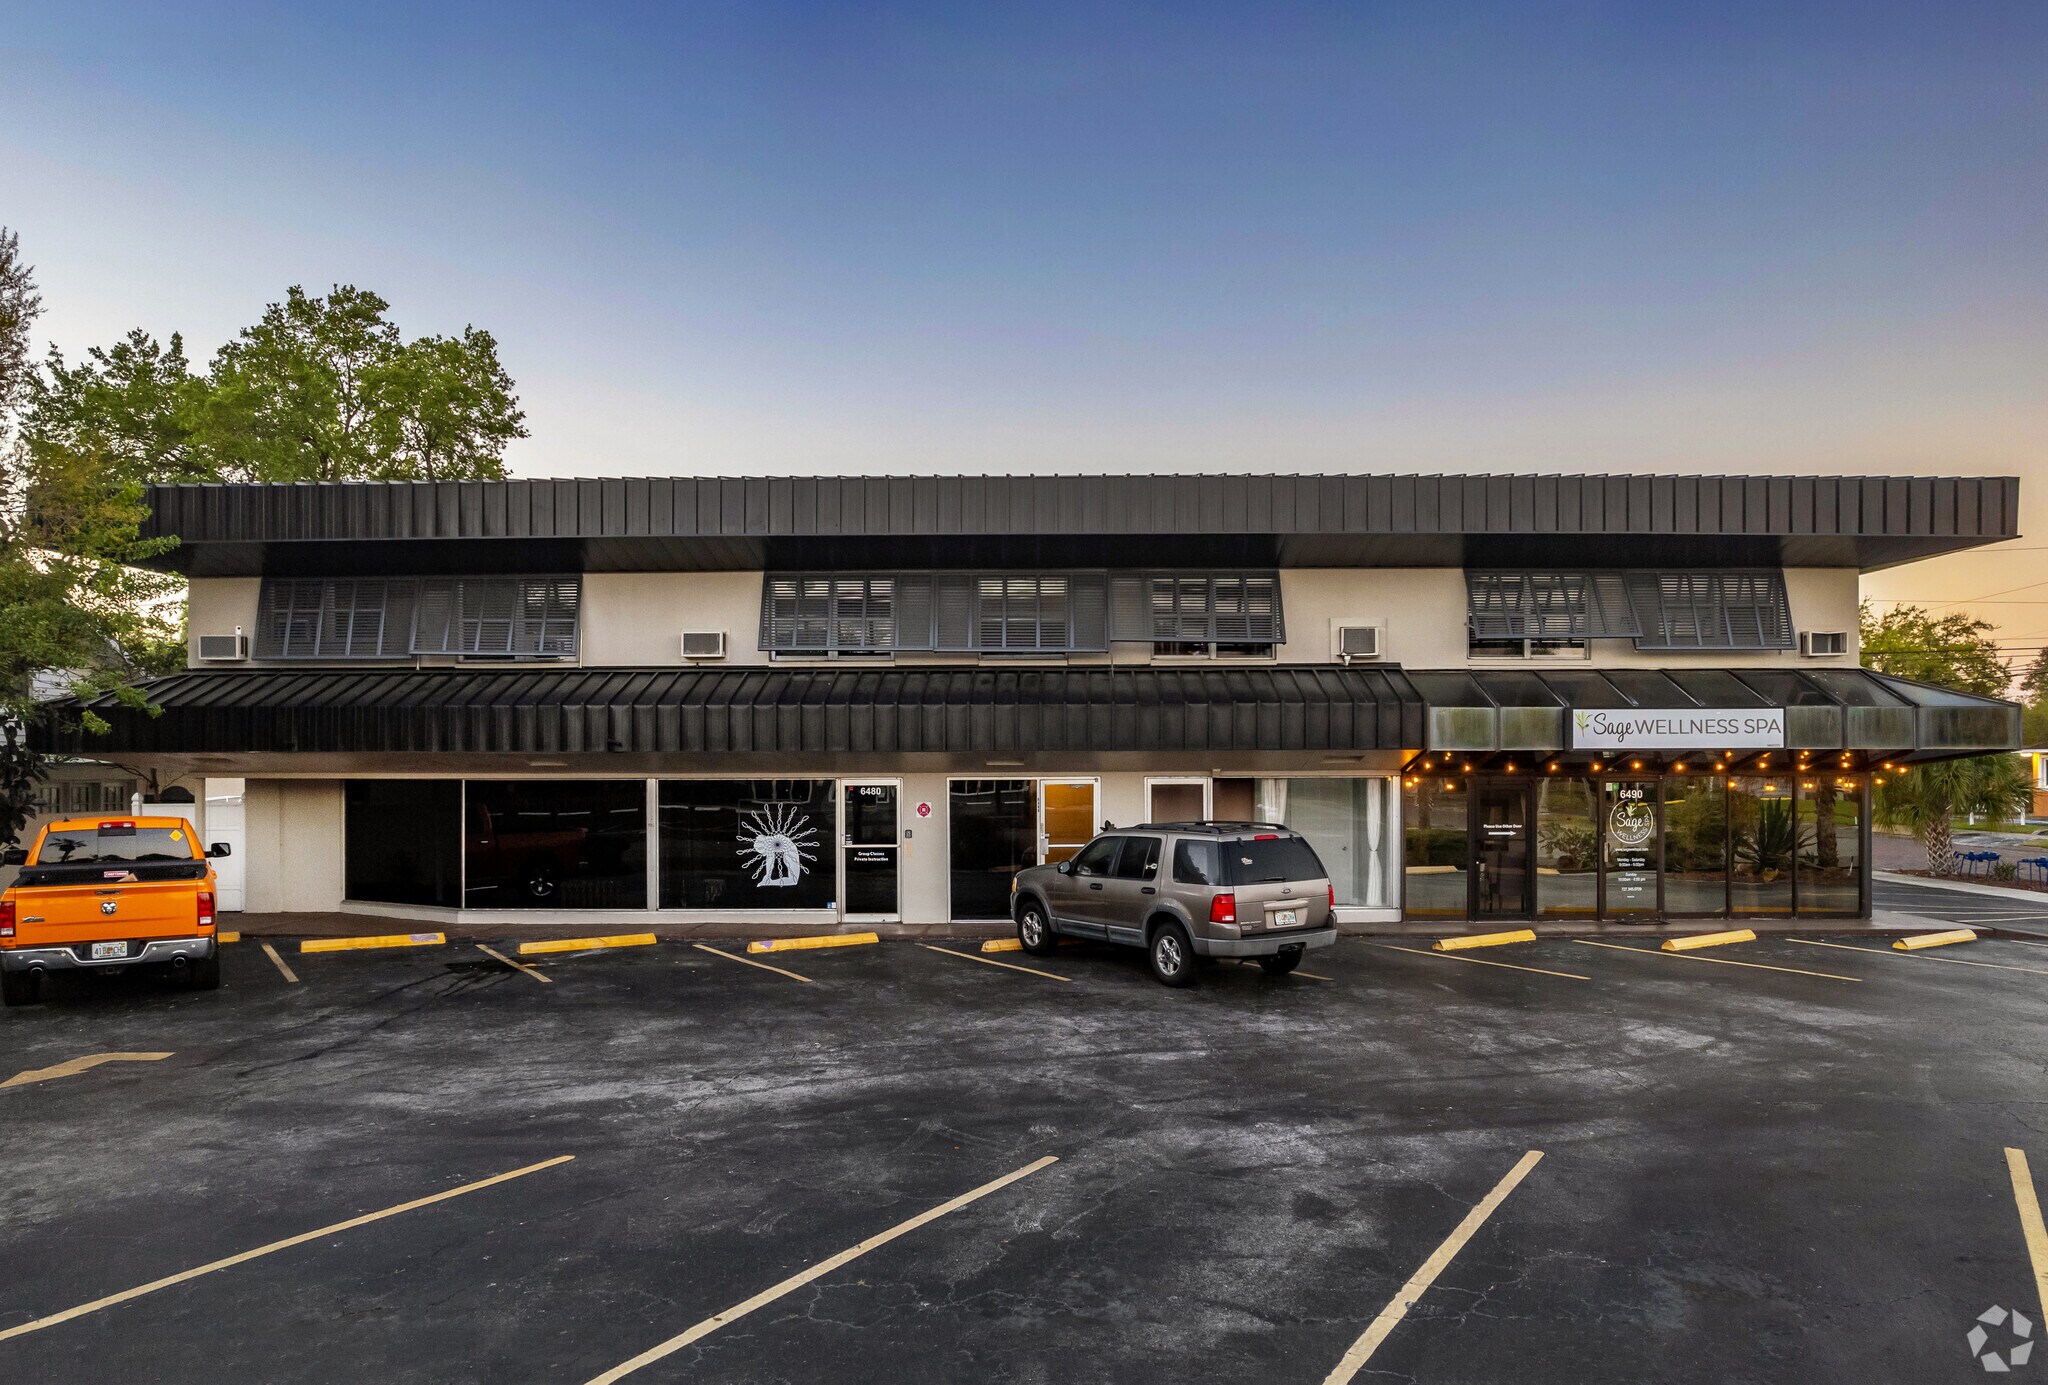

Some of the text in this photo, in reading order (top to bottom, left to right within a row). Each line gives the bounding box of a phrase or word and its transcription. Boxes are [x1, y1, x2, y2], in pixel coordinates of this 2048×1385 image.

[1592, 712, 1782, 743] Sage WELLNESS SPA
[860, 787, 882, 795] 6480
[1620, 789, 1643, 799] 6490
[1616, 811, 1644, 833] Sage
[1616, 828, 1648, 840] WELLNESS
